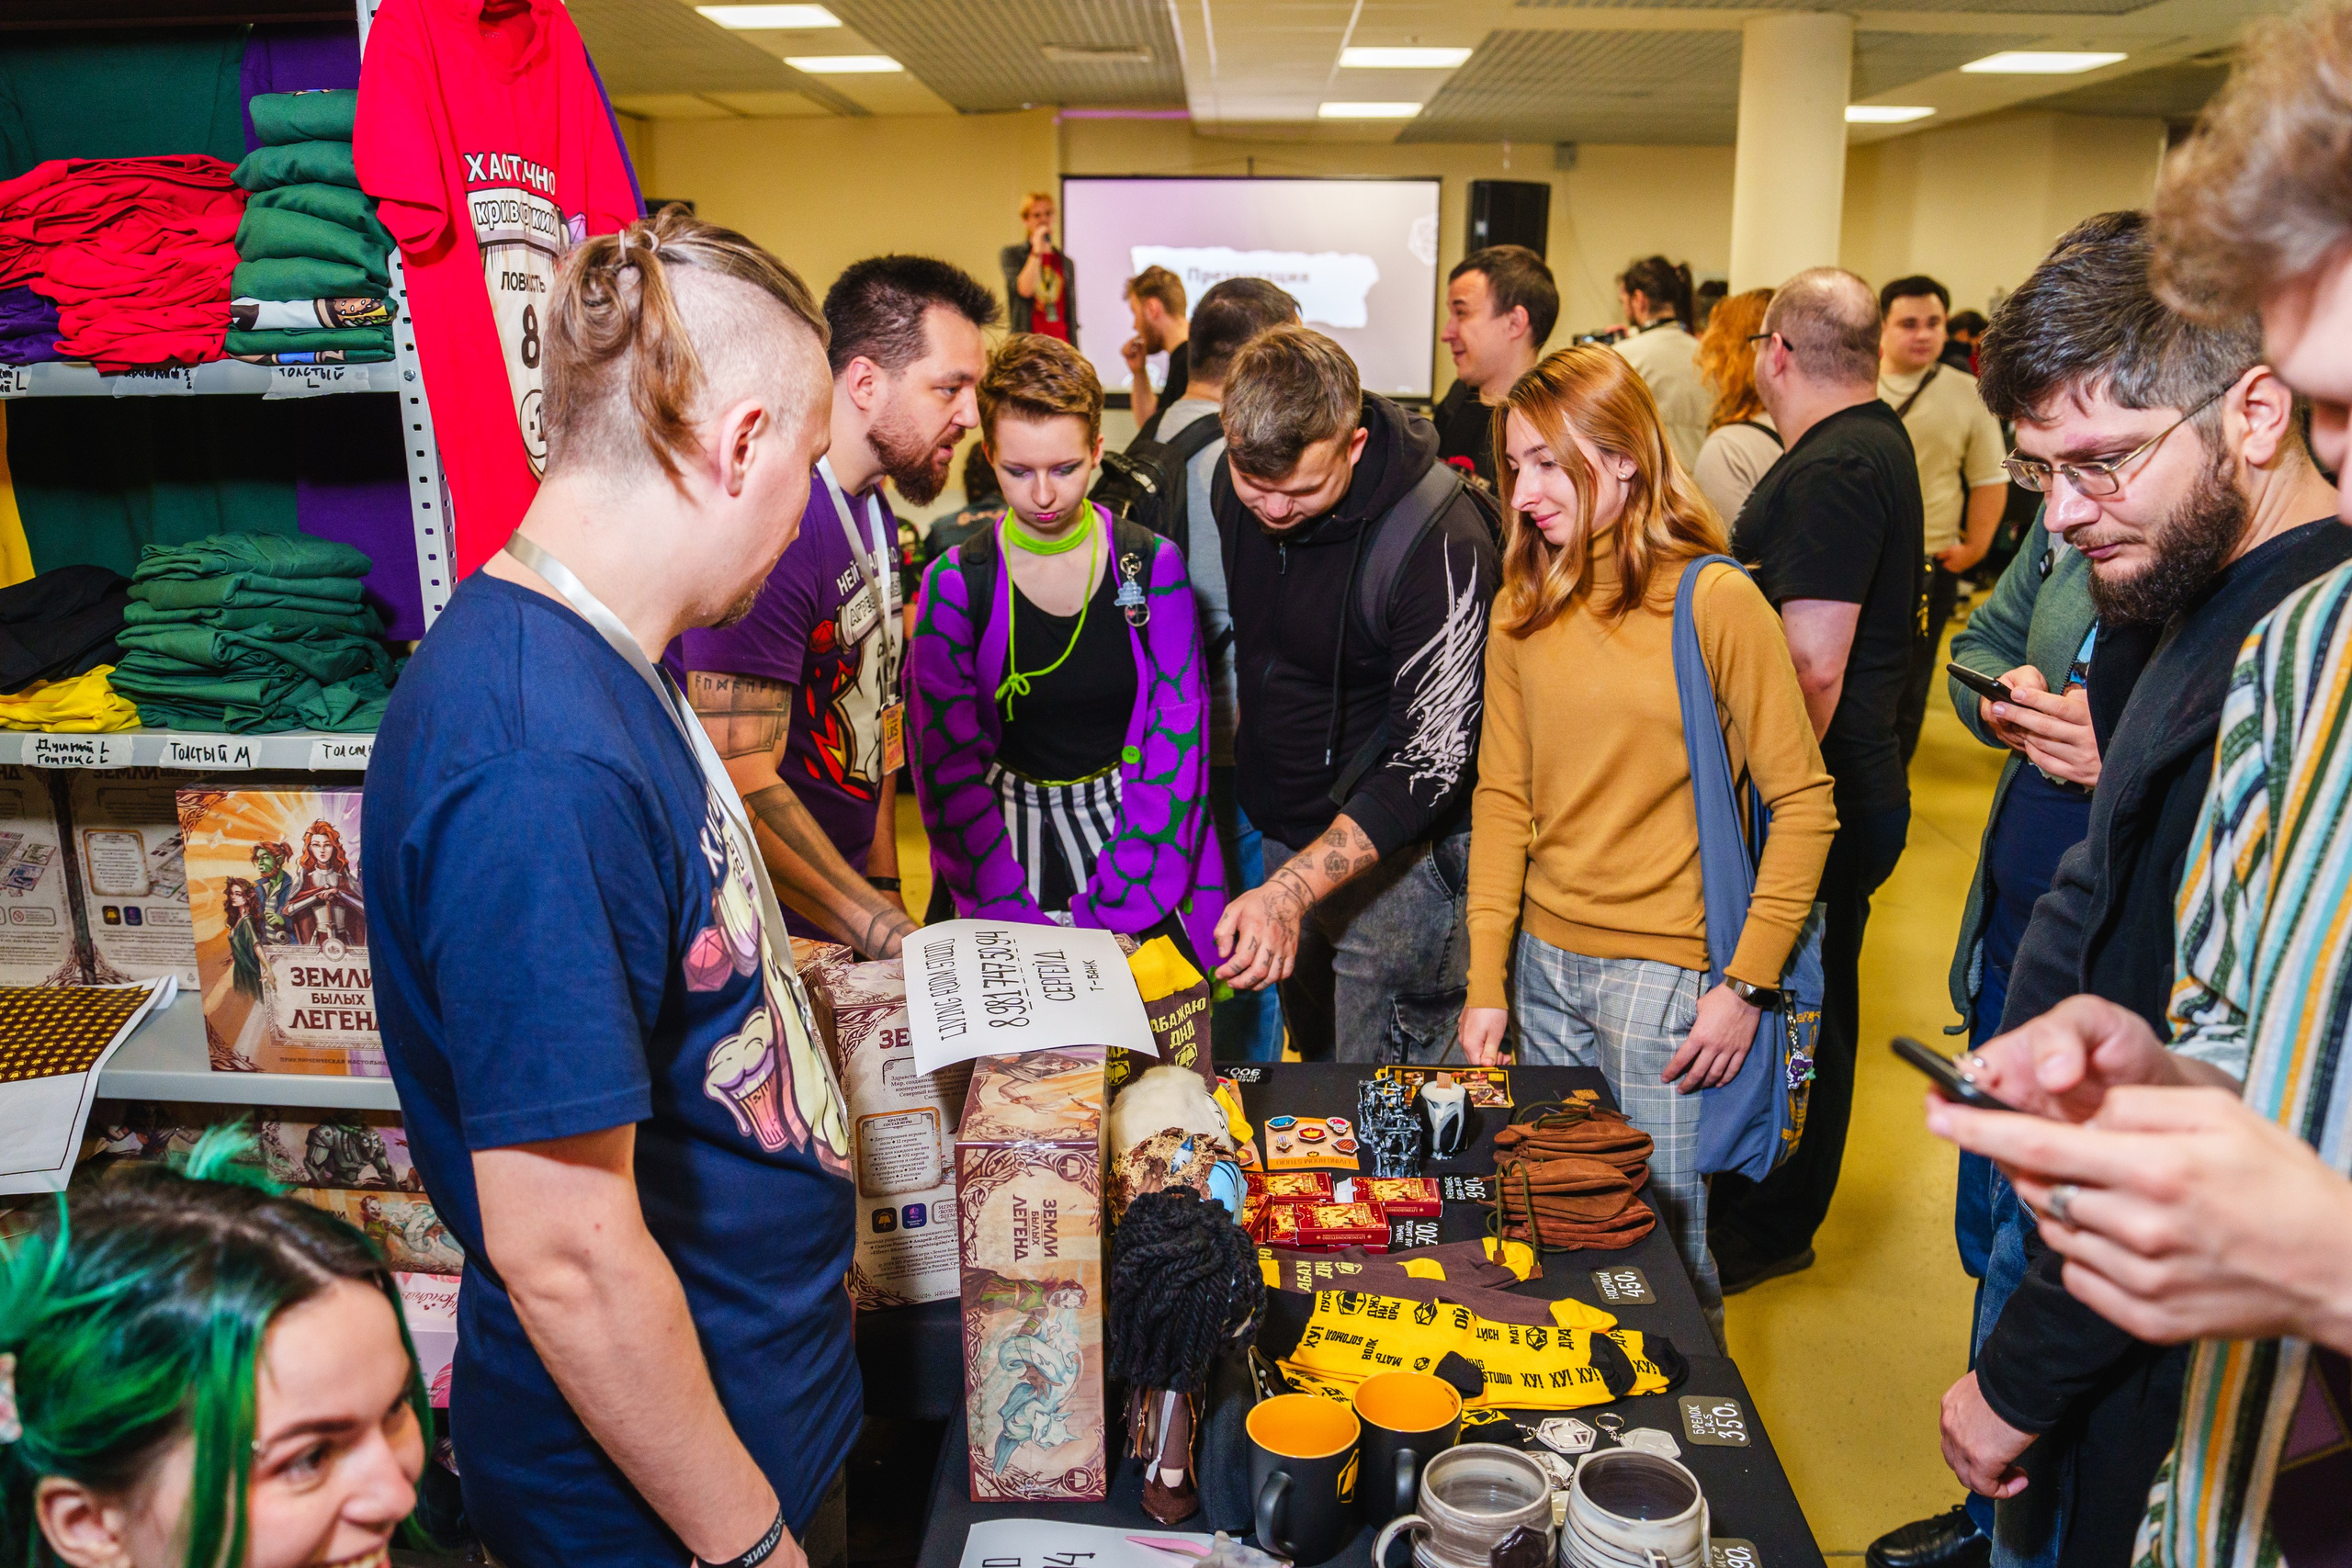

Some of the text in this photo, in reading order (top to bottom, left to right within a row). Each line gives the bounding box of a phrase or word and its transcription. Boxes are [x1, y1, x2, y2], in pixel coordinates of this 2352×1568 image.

[464, 152, 556, 196] ХАОТЧНО
[501, 271, 547, 293] ЛОВСТЬ
[521, 304, 540, 369] 8
[924, 938, 956, 970] STUDIO
[927, 968, 961, 998] ROOM
[975, 931, 1030, 1028] 8 981 747 50 94
[1032, 961, 1076, 1001] СЕРГЕЙ
[311, 993, 366, 1005] БЫЛЫХ
[934, 998, 967, 1041] LIVING
[879, 1027, 913, 1049] ЗЕ
[1170, 1020, 1195, 1049] ДНД
[1012, 1194, 1029, 1263] ЛЕГЕНД
[1031, 1211, 1040, 1246] БЫЛЫХ
[1043, 1199, 1058, 1258] ЗЕМЛИ
[1315, 1261, 1333, 1279] ДН
[1596, 1271, 1620, 1300] НОСОЧКИ
[1320, 1291, 1332, 1313] ПУС
[1387, 1302, 1402, 1320] ОРЫ
[1303, 1325, 1325, 1348] ХУ!
[1325, 1329, 1364, 1346] БОГОМОЛ
[1558, 1326, 1575, 1350] ДРА
[1362, 1338, 1379, 1360] ВОЛК
[1375, 1352, 1403, 1367] МАТЬ
[1483, 1371, 1513, 1385] STUDIO
[1576, 1367, 1600, 1383] ХУ!
[1633, 1359, 1657, 1375] ХУ!
[1521, 1372, 1544, 1389] ХУ!
[1549, 1370, 1574, 1388] ХУ!
[1687, 1404, 1706, 1435] БРЕЛОК
